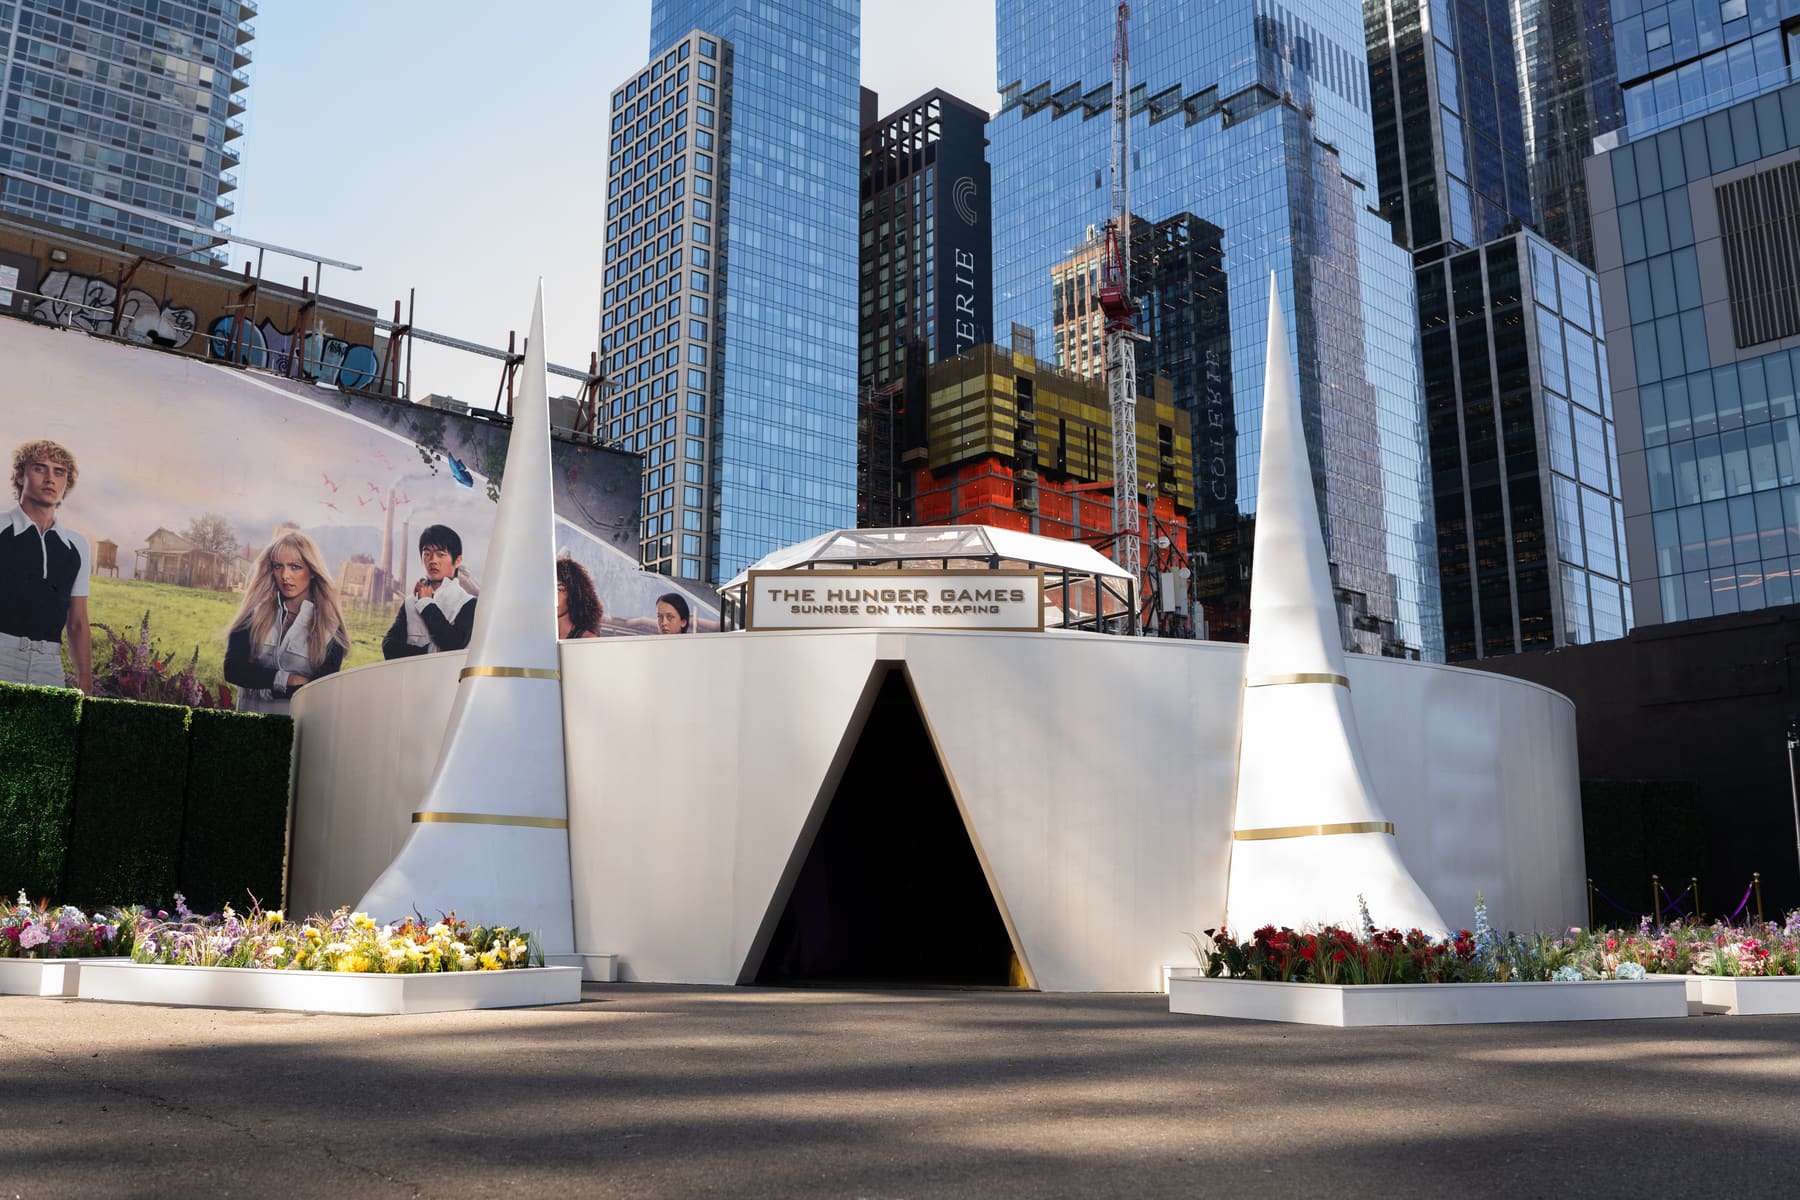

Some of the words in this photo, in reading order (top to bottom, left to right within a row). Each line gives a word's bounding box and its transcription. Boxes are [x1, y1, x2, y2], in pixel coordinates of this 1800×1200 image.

[768, 589, 815, 602] THE
[827, 589, 928, 602] HUNGER
[940, 589, 1025, 602] GAMES
[790, 605, 859, 614] SUNRISE
[866, 605, 889, 614] ON
[894, 605, 925, 614] THE
[932, 605, 1000, 614] REAPING
